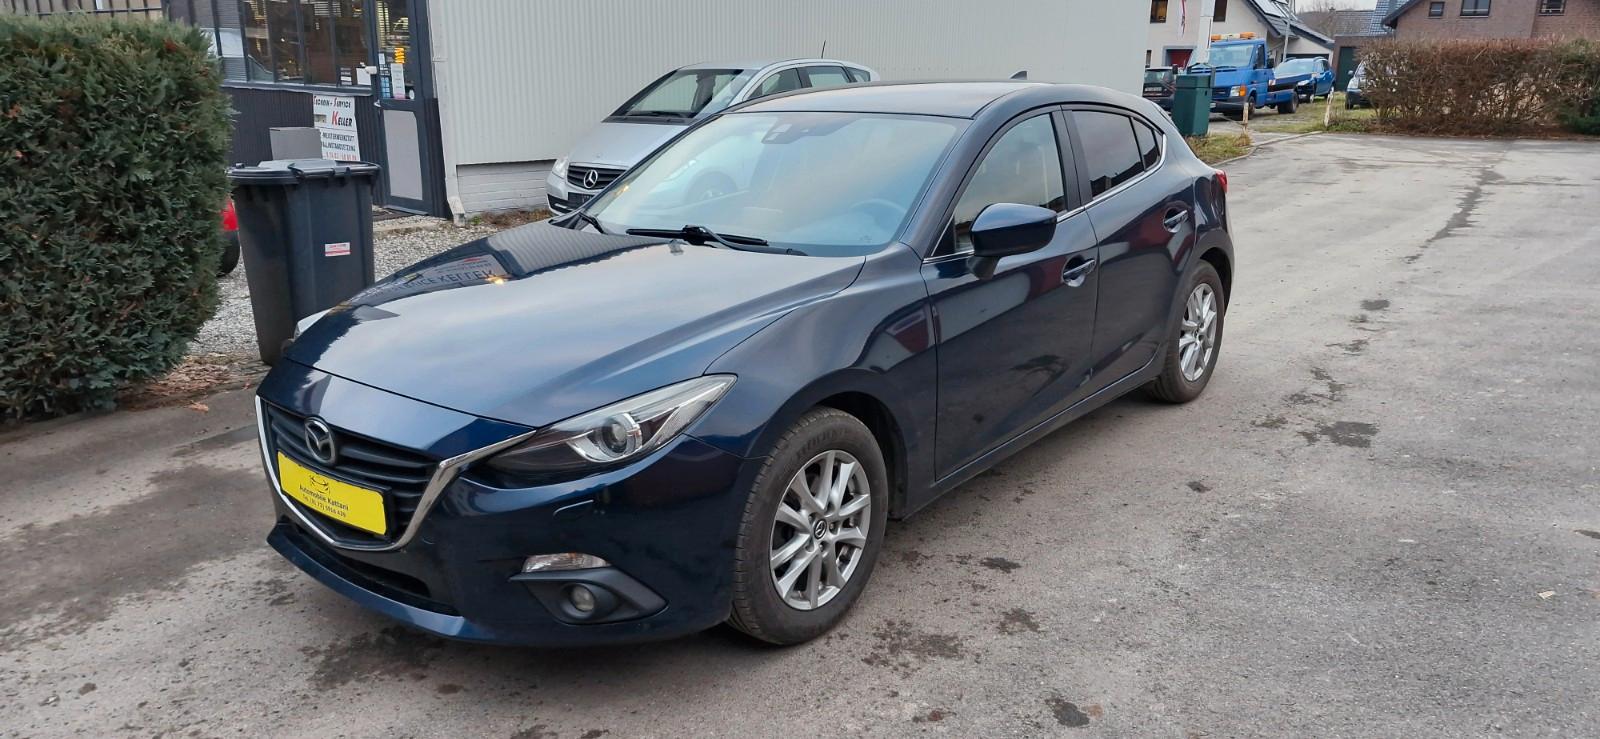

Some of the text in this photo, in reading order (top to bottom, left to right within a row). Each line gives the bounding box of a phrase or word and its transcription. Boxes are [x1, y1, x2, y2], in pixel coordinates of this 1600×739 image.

[332, 111, 352, 126] KELLER
[300, 484, 349, 511] Automobile Kattani
